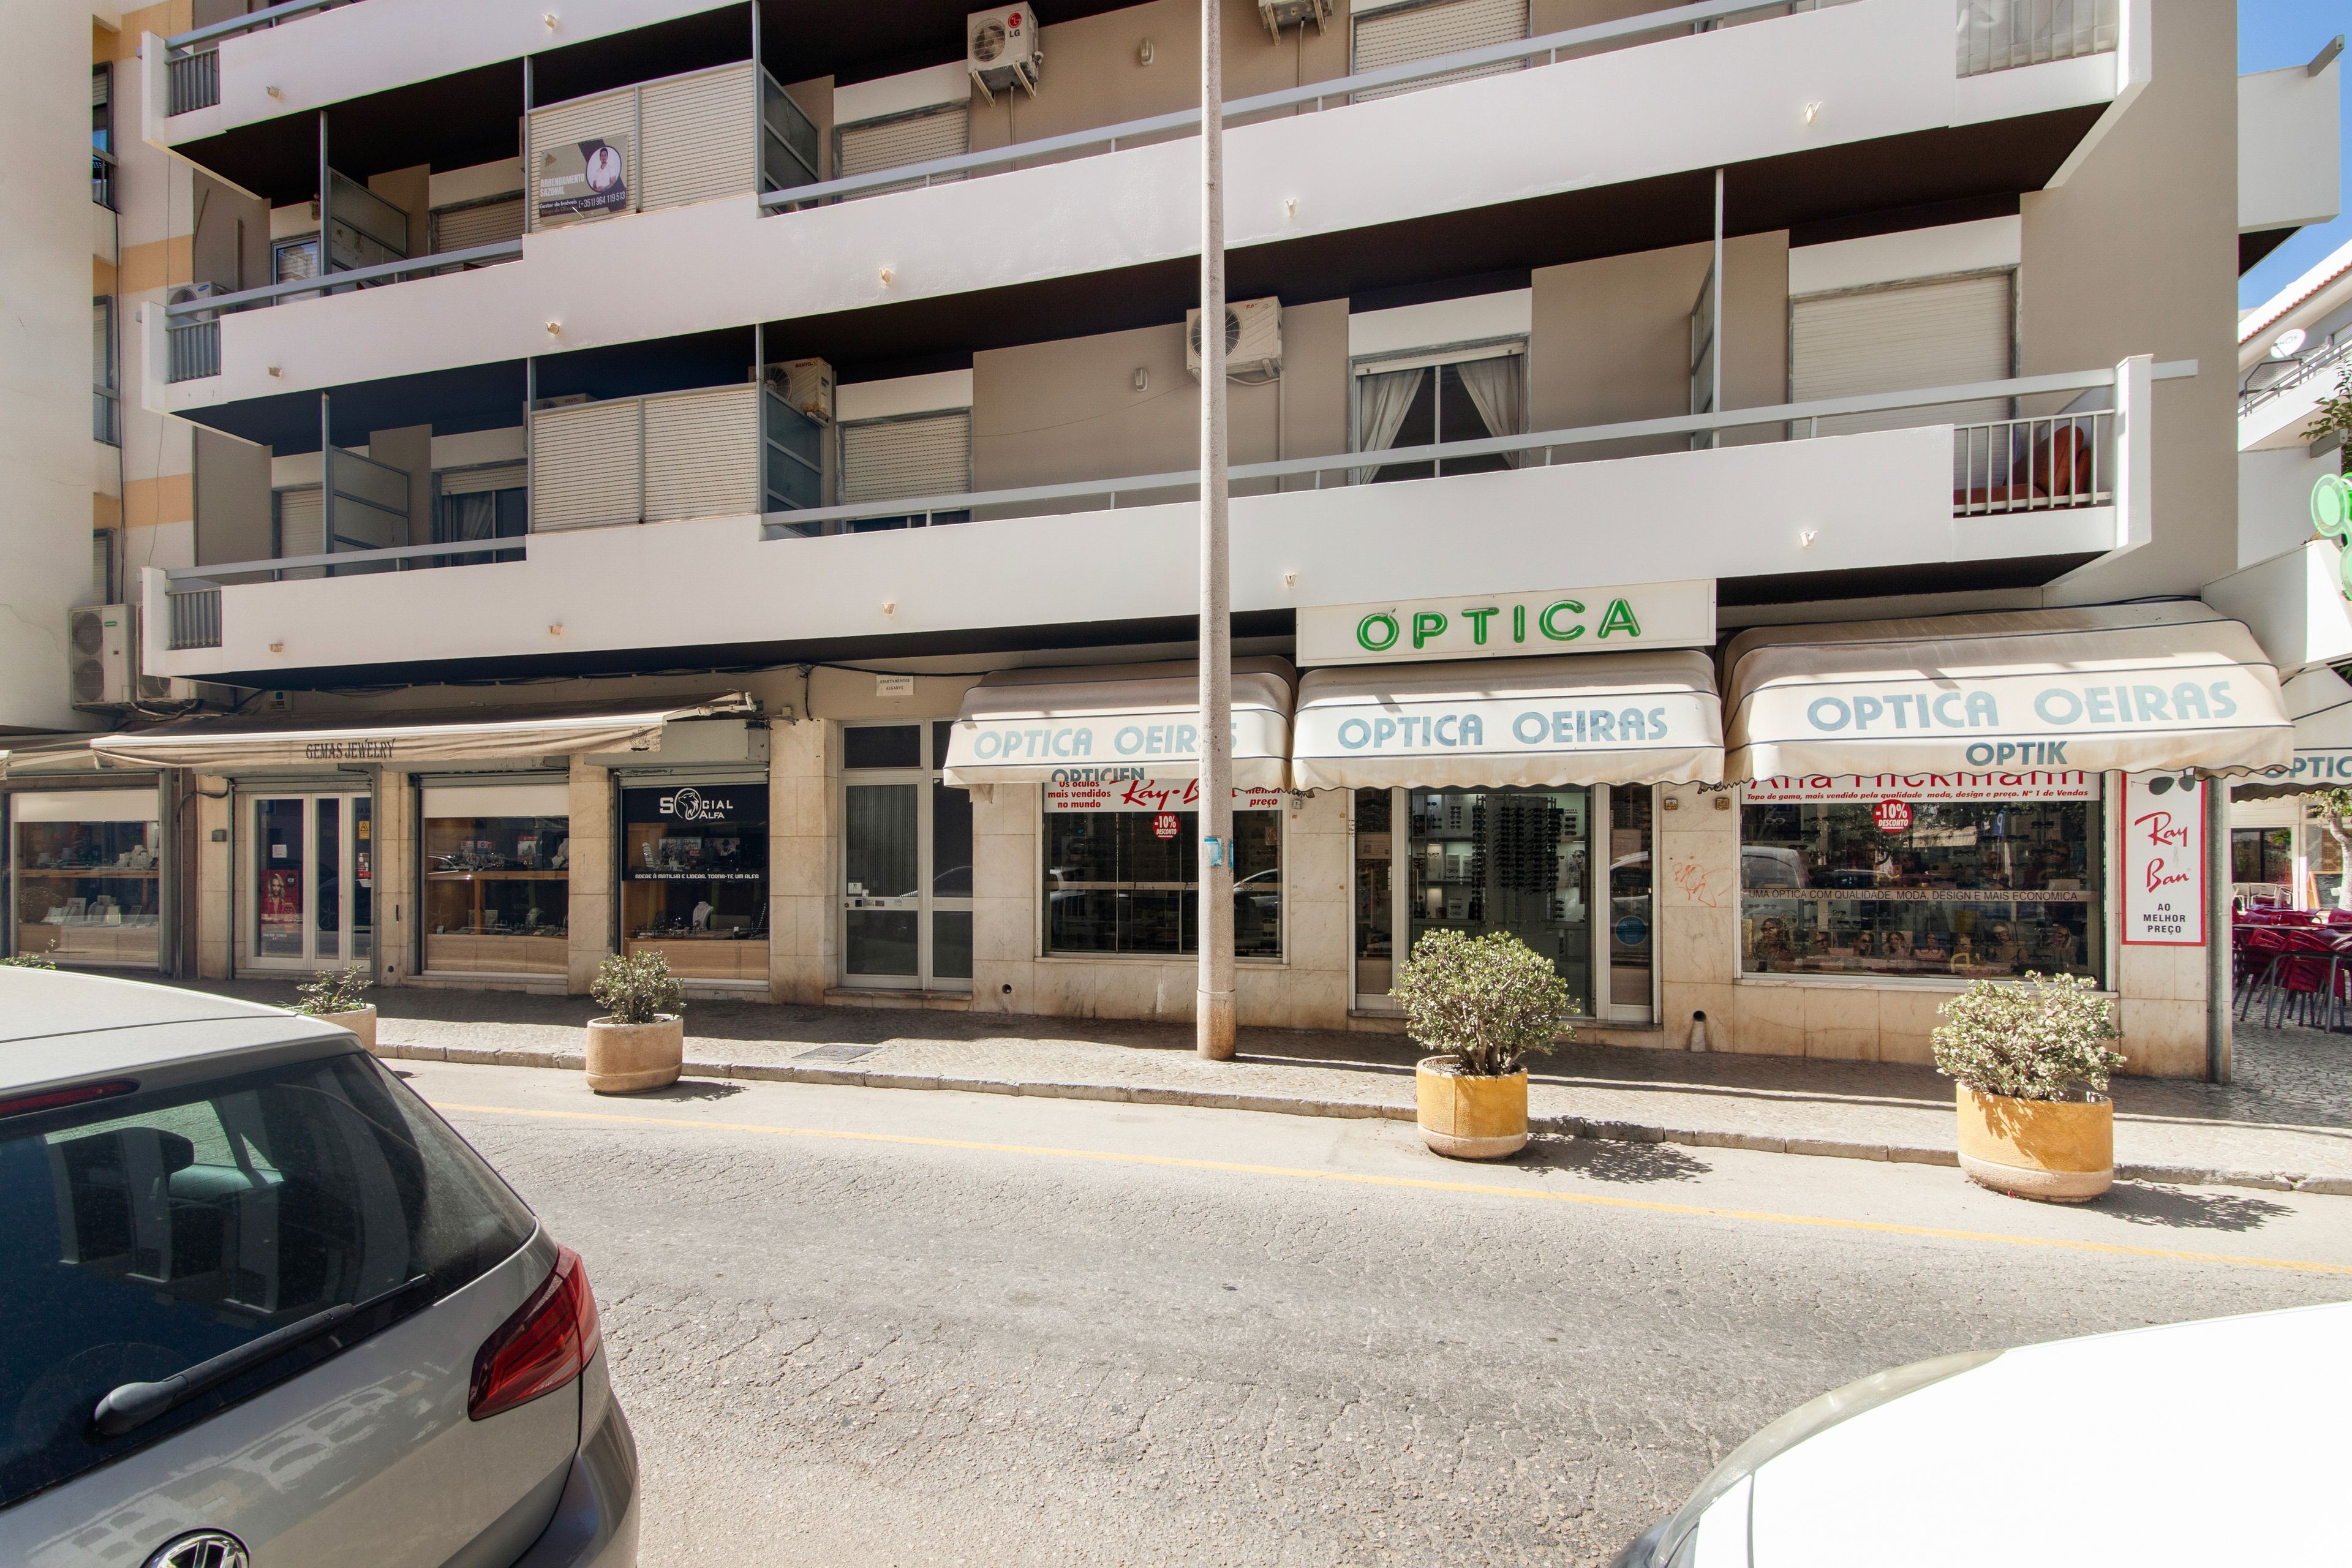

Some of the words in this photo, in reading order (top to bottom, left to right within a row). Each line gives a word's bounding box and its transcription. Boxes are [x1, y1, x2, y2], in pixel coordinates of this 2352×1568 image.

[540, 173, 585, 187] ARRENDAMENTO
[540, 186, 565, 197] SAZONAL
[578, 198, 595, 208] (+351)
[596, 195, 606, 205] 964
[607, 194, 616, 203] 119
[616, 190, 625, 201] 513
[1806, 691, 2000, 732] OPTICA
[2034, 681, 2237, 725] OEIRAS
[1337, 713, 1483, 750] OPTICA
[1512, 707, 1668, 744] OEIRAS
[306, 742, 342, 759] GEMAS
[345, 737, 396, 759] JEWELRY
[973, 727, 1093, 760] OPTICA
[1114, 723, 1237, 755] OEIR
[1966, 741, 2068, 766] OPTIK
[1051, 767, 1145, 782] OPTICIEN
[2266, 756, 2352, 778] PTIC
[1048, 790, 1069, 798] mais
[1071, 789, 1111, 797] vendidos
[1071, 799, 1101, 808] mundo
[1249, 798, 1278, 807] preço
[699, 810, 725, 819] ALFA
[1875, 803, 1908, 819] -10%
[1155, 815, 1176, 828] -10%
[2134, 811, 2188, 847] Ray
[2146, 858, 2190, 894] Ban
[1749, 889, 1770, 899] UMA
[1809, 890, 1832, 899] COM
[1834, 890, 1894, 900] QUALIDADE,
[1896, 891, 1929, 900] MODA,
[1932, 891, 1971, 900] DESIGN
[1974, 891, 1981, 900] E
[1984, 891, 2010, 900] MAIS
[2143, 914, 2186, 922] MELHOR
[2147, 925, 2182, 935] PREÇO
